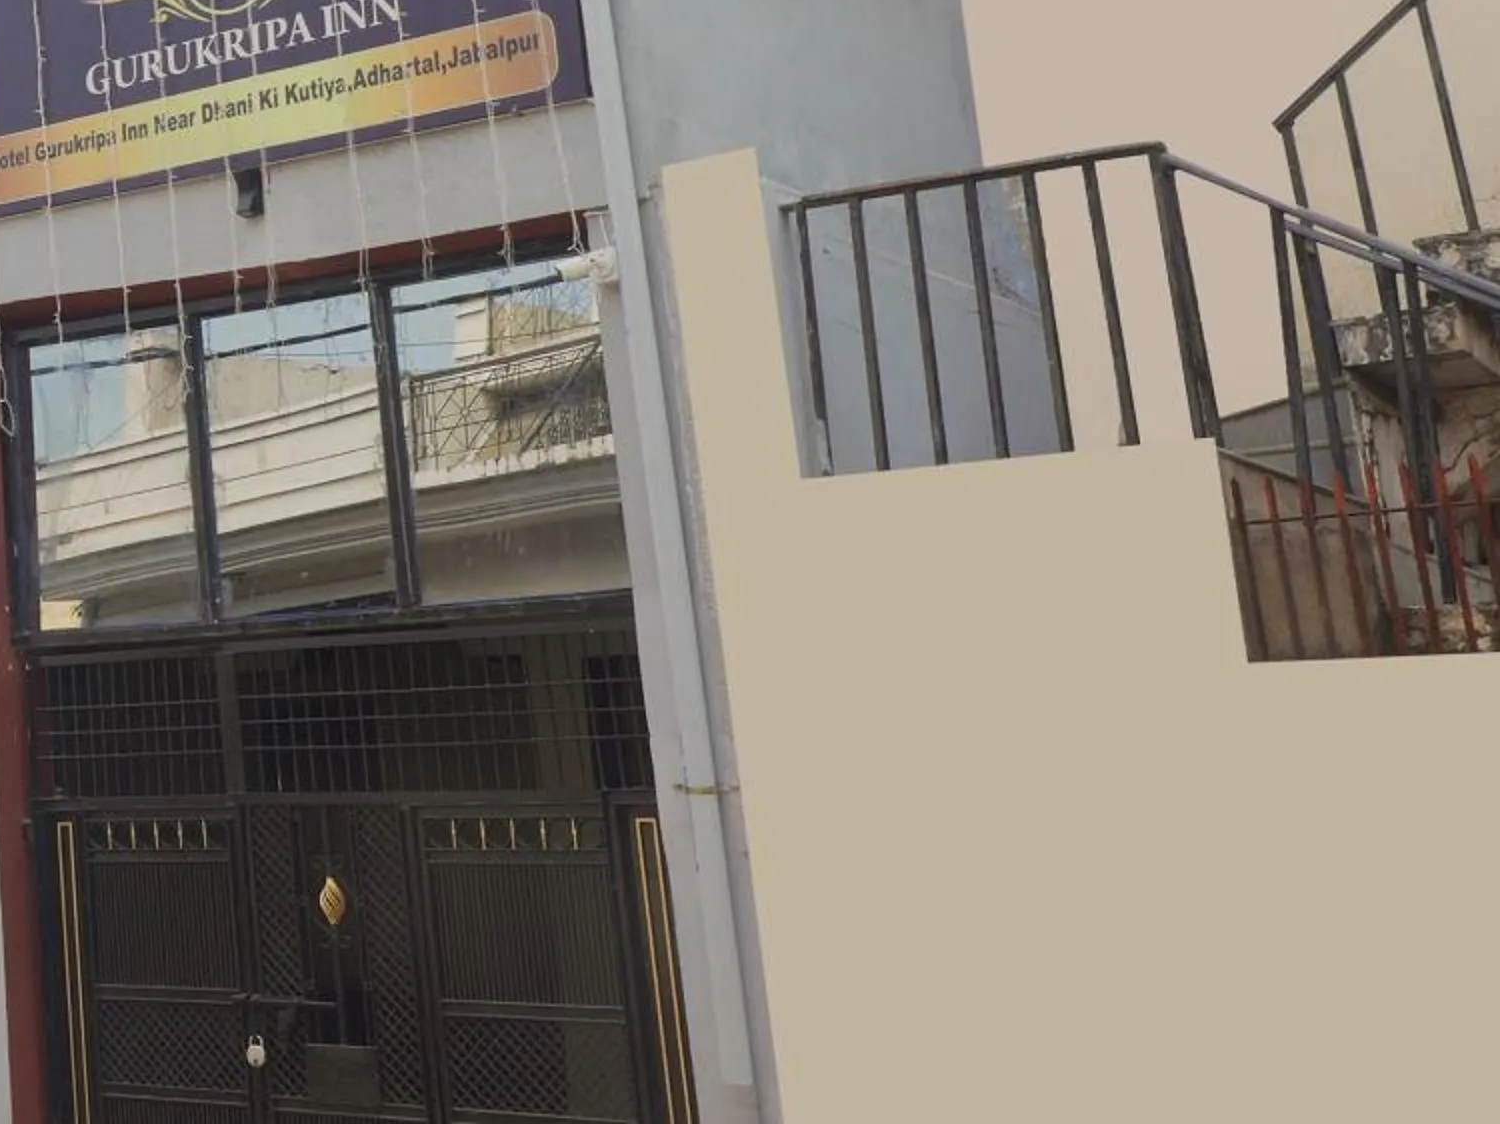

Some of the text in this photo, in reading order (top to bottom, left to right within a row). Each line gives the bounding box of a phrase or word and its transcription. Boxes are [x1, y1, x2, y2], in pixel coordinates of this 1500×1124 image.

[85, 11, 315, 96] GURUKRIPA
[35, 129, 117, 163] Gurukripa
[121, 121, 149, 143] Inn
[153, 109, 197, 135] Near
[259, 87, 280, 112] Ki
